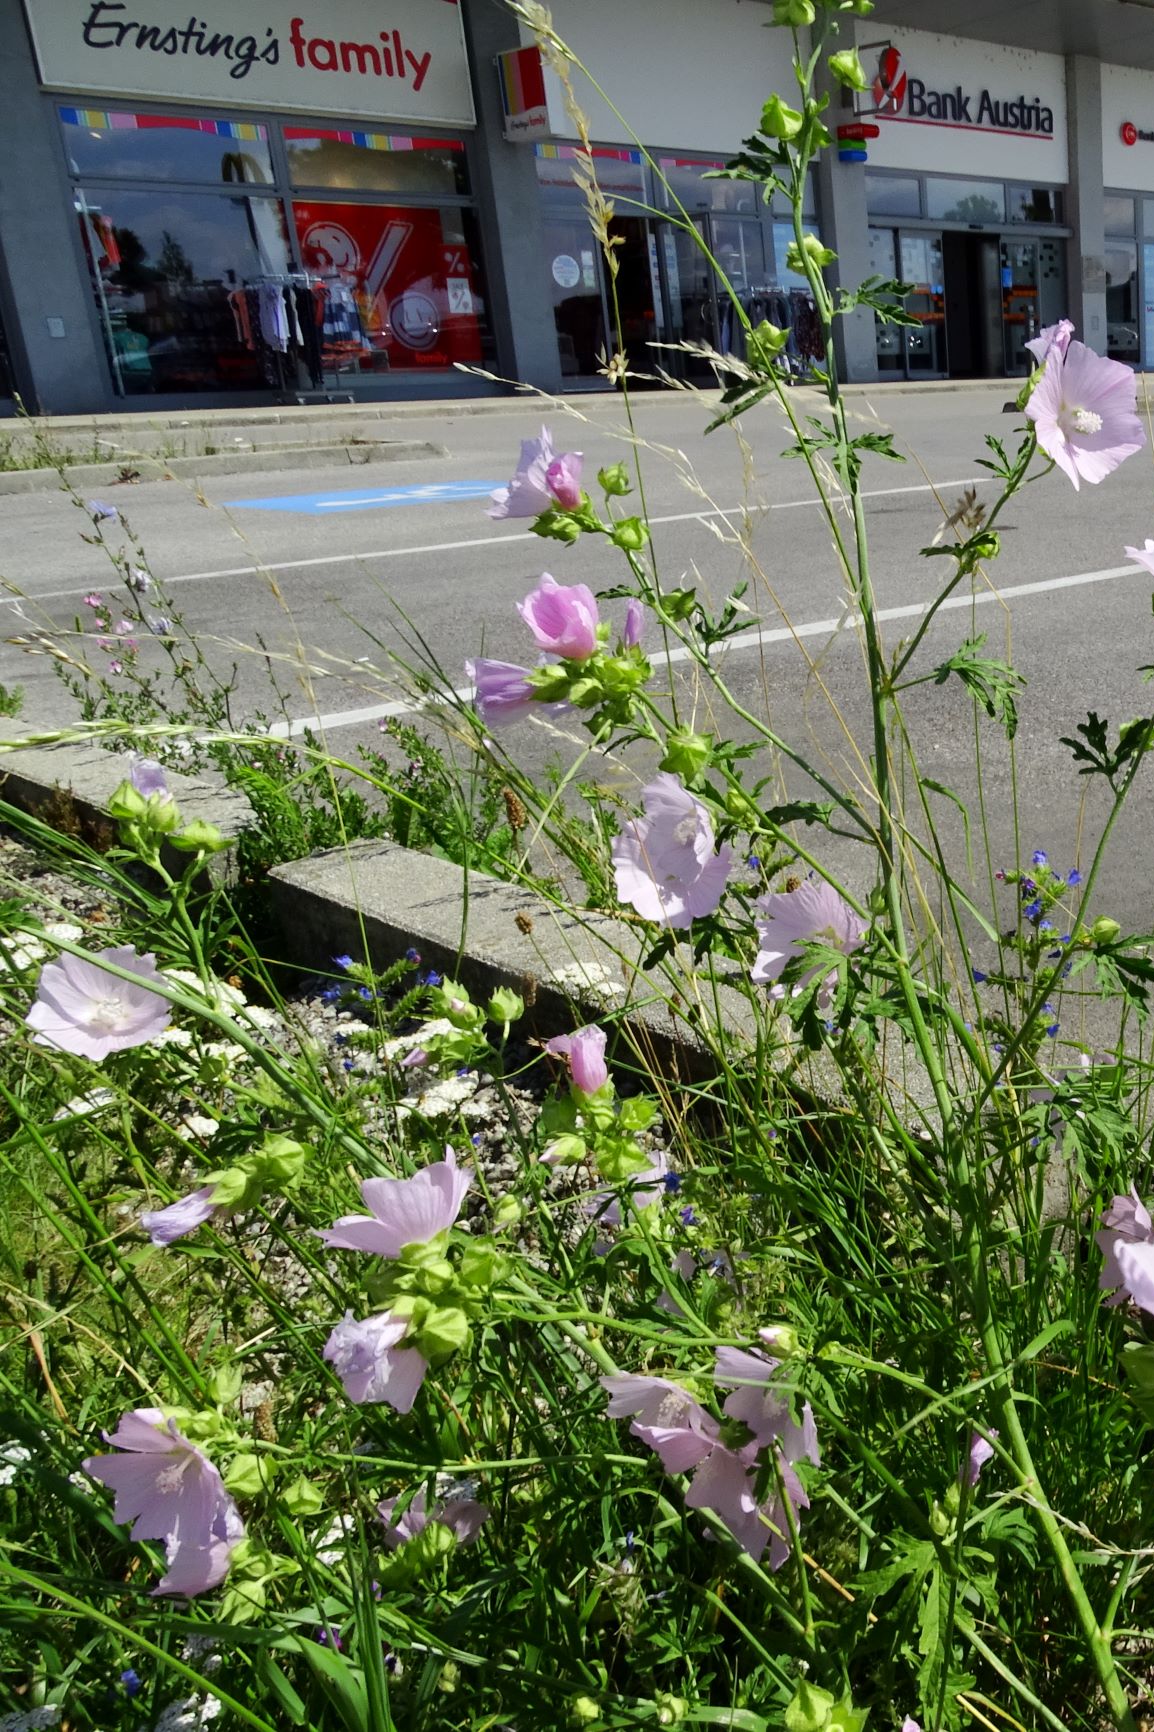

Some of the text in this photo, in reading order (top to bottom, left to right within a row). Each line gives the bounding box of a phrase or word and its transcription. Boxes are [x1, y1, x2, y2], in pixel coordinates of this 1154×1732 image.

[82, 2, 432, 91] Ernsting's family
[907, 78, 1054, 134] Bank Austria
